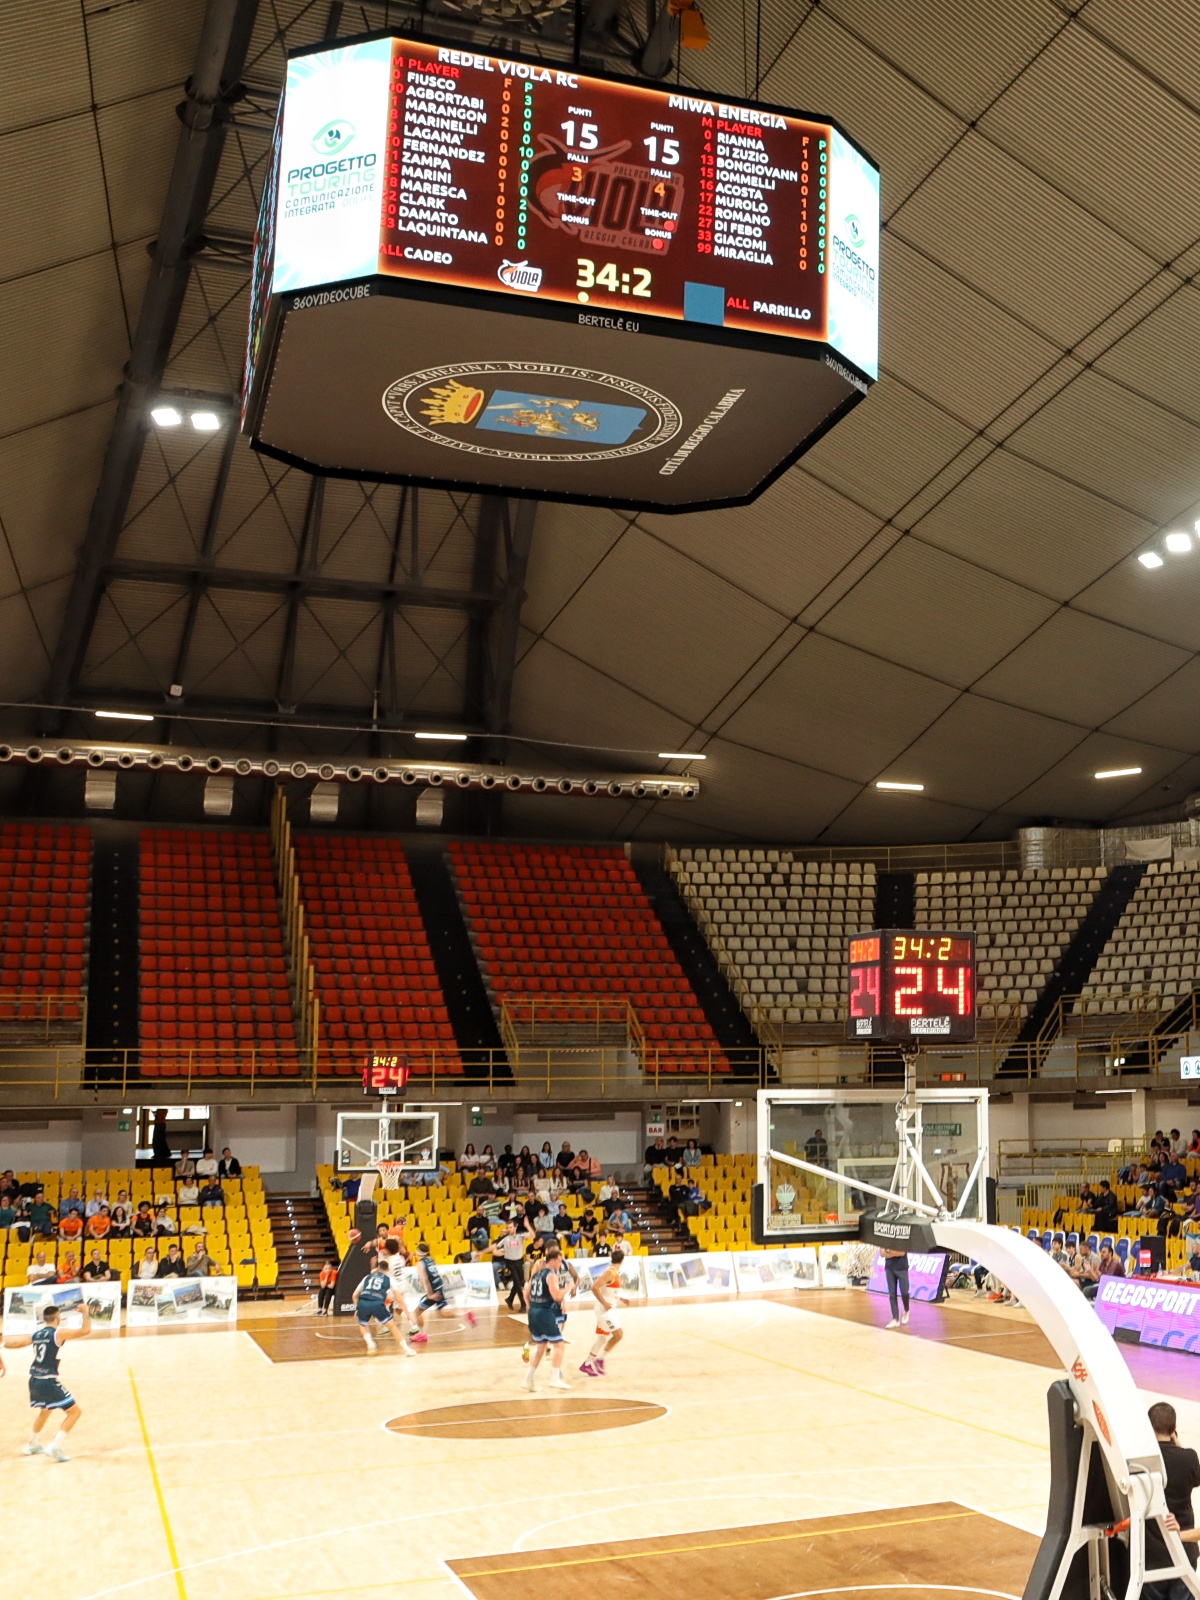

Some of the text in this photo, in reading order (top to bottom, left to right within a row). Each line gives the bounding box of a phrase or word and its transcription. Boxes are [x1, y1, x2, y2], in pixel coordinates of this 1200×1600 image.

[392, 56, 533, 92] M PLAYER F P
[438, 48, 579, 89] REDEL VIOLA RC
[406, 85, 483, 110] AGBORTABI
[524, 108, 532, 118] 0
[407, 72, 456, 90] FIUSCO
[524, 95, 532, 106] 3
[405, 98, 487, 123] MARANGON
[523, 121, 531, 131] 0
[568, 106, 592, 117] PUNTI
[669, 95, 787, 130] MIWA ENERGIA
[404, 125, 463, 145] LAGANA'
[519, 146, 534, 158] 10
[405, 111, 477, 135] MARINELLI
[523, 134, 531, 144] 0
[561, 120, 598, 150] 15
[651, 122, 673, 133] PUNTI
[702, 117, 826, 150] M PLAYER F P
[403, 138, 485, 163] FERNANDEZ
[521, 160, 529, 170] 0
[567, 153, 588, 163] FALLI
[643, 136, 680, 165] 15
[704, 130, 827, 162] 0 RIANNA 0
[704, 143, 827, 174] 4 DI ZUZIO 0 0
[288, 154, 376, 183] PROGETTO
[288, 168, 375, 196] TOURING
[401, 165, 451, 184] MARINI
[520, 186, 528, 197] 0
[402, 152, 450, 170] ZAMPA
[520, 173, 529, 183] 0
[572, 167, 582, 182] 3
[651, 169, 671, 178] FALLI
[700, 167, 826, 199] 15 IOMMELLI 0 0
[701, 155, 826, 186] 13 BONGIOVANN 0 0
[285, 184, 374, 208] COMUNICAZIONE
[401, 179, 467, 200] MARESCA
[519, 199, 527, 210] 2
[557, 193, 595, 206] TIME-OUT
[654, 183, 665, 197] 4
[700, 180, 826, 211] 16 ACOSTA 4
[285, 201, 335, 219] INTEGRATA
[399, 206, 458, 225] DAMATO
[518, 226, 526, 236] 0
[400, 192, 445, 210] CLARK
[519, 213, 526, 223] 0
[562, 215, 589, 225] BONUS
[640, 207, 678, 220] TIME-OUT
[699, 205, 826, 236] 22 ROMANO 0 0
[700, 192, 826, 224] 17 MUROLO 4
[398, 219, 488, 244] LAQUINTANA
[517, 239, 525, 250] 0
[645, 228, 671, 239] BONUS
[698, 217, 825, 248] 27 DI FEBO 6
[698, 230, 807, 258] 33 GIACOMI 0
[379, 244, 452, 264] ALL CADEO
[697, 243, 825, 273] 99 MIRAGLIA 0 0
[832, 235, 875, 281] PROGETTO
[576, 258, 651, 298] 34:2
[726, 298, 811, 320] ALL PARRILLO
[626, 321, 639, 332] EU
[704, 389, 745, 424] CALABRIA
[894, 937, 951, 960] 34:2
[851, 966, 880, 1016] 24
[895, 967, 965, 1015] 24
[372, 1068, 403, 1087] 24
[366, 1278, 383, 1290] 15
[1101, 1281, 1200, 1316] GECOSPORT
